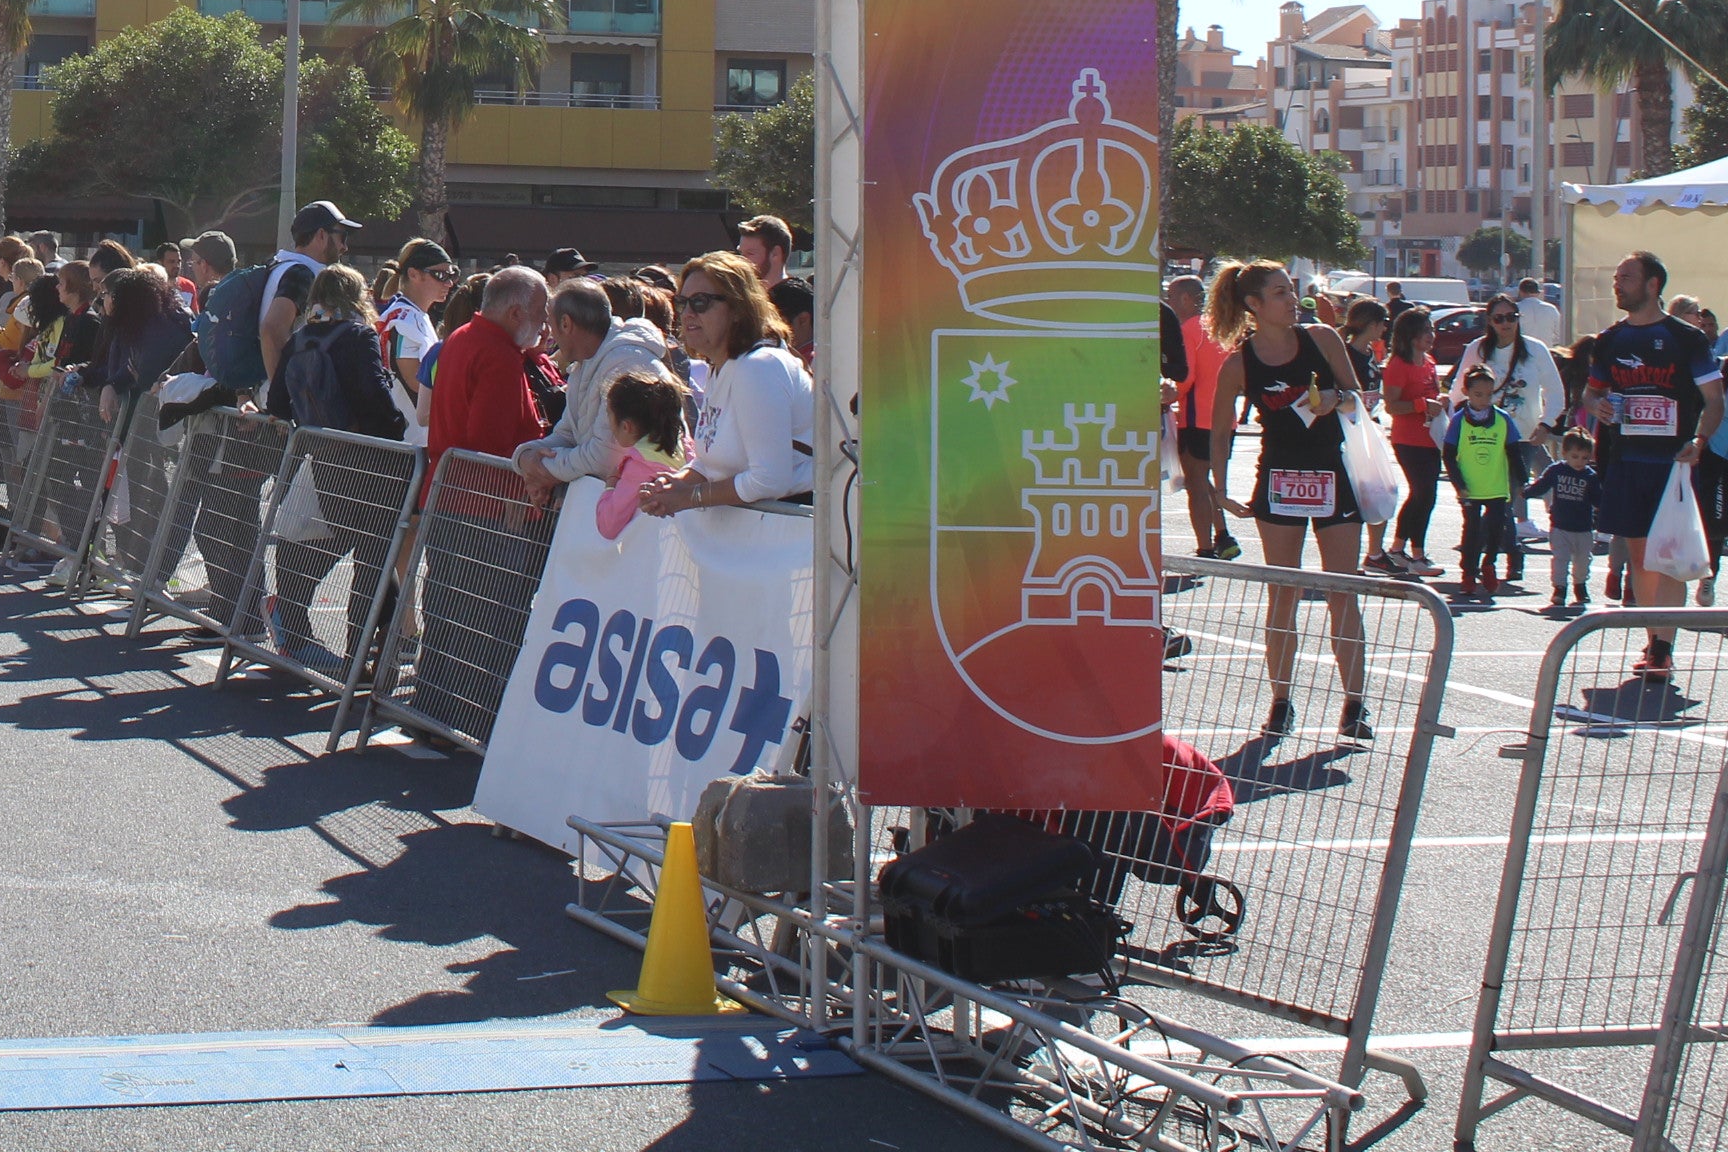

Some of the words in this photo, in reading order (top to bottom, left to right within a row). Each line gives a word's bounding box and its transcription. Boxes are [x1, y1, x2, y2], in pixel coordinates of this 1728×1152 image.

[1634, 407, 1662, 419] 676
[1557, 475, 1587, 488] WILD
[1286, 483, 1318, 498] 700
[1557, 483, 1584, 496] DUDE
[534, 598, 736, 762] asisa
